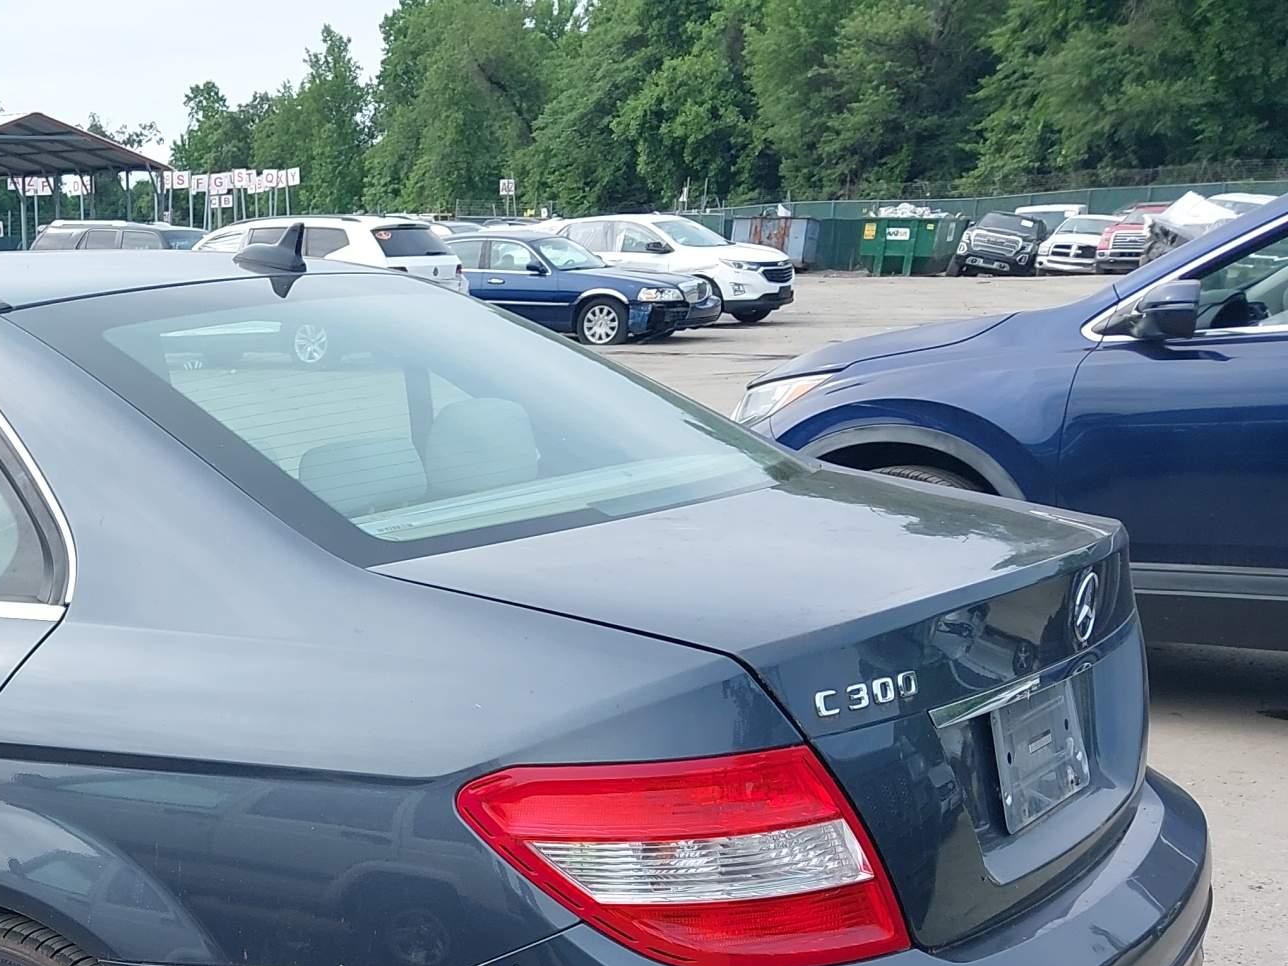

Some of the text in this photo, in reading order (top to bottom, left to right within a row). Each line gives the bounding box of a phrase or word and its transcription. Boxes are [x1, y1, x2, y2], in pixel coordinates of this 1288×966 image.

[177, 175, 184, 185] S
[214, 177, 223, 187] G
[814, 670, 918, 718] C 300
